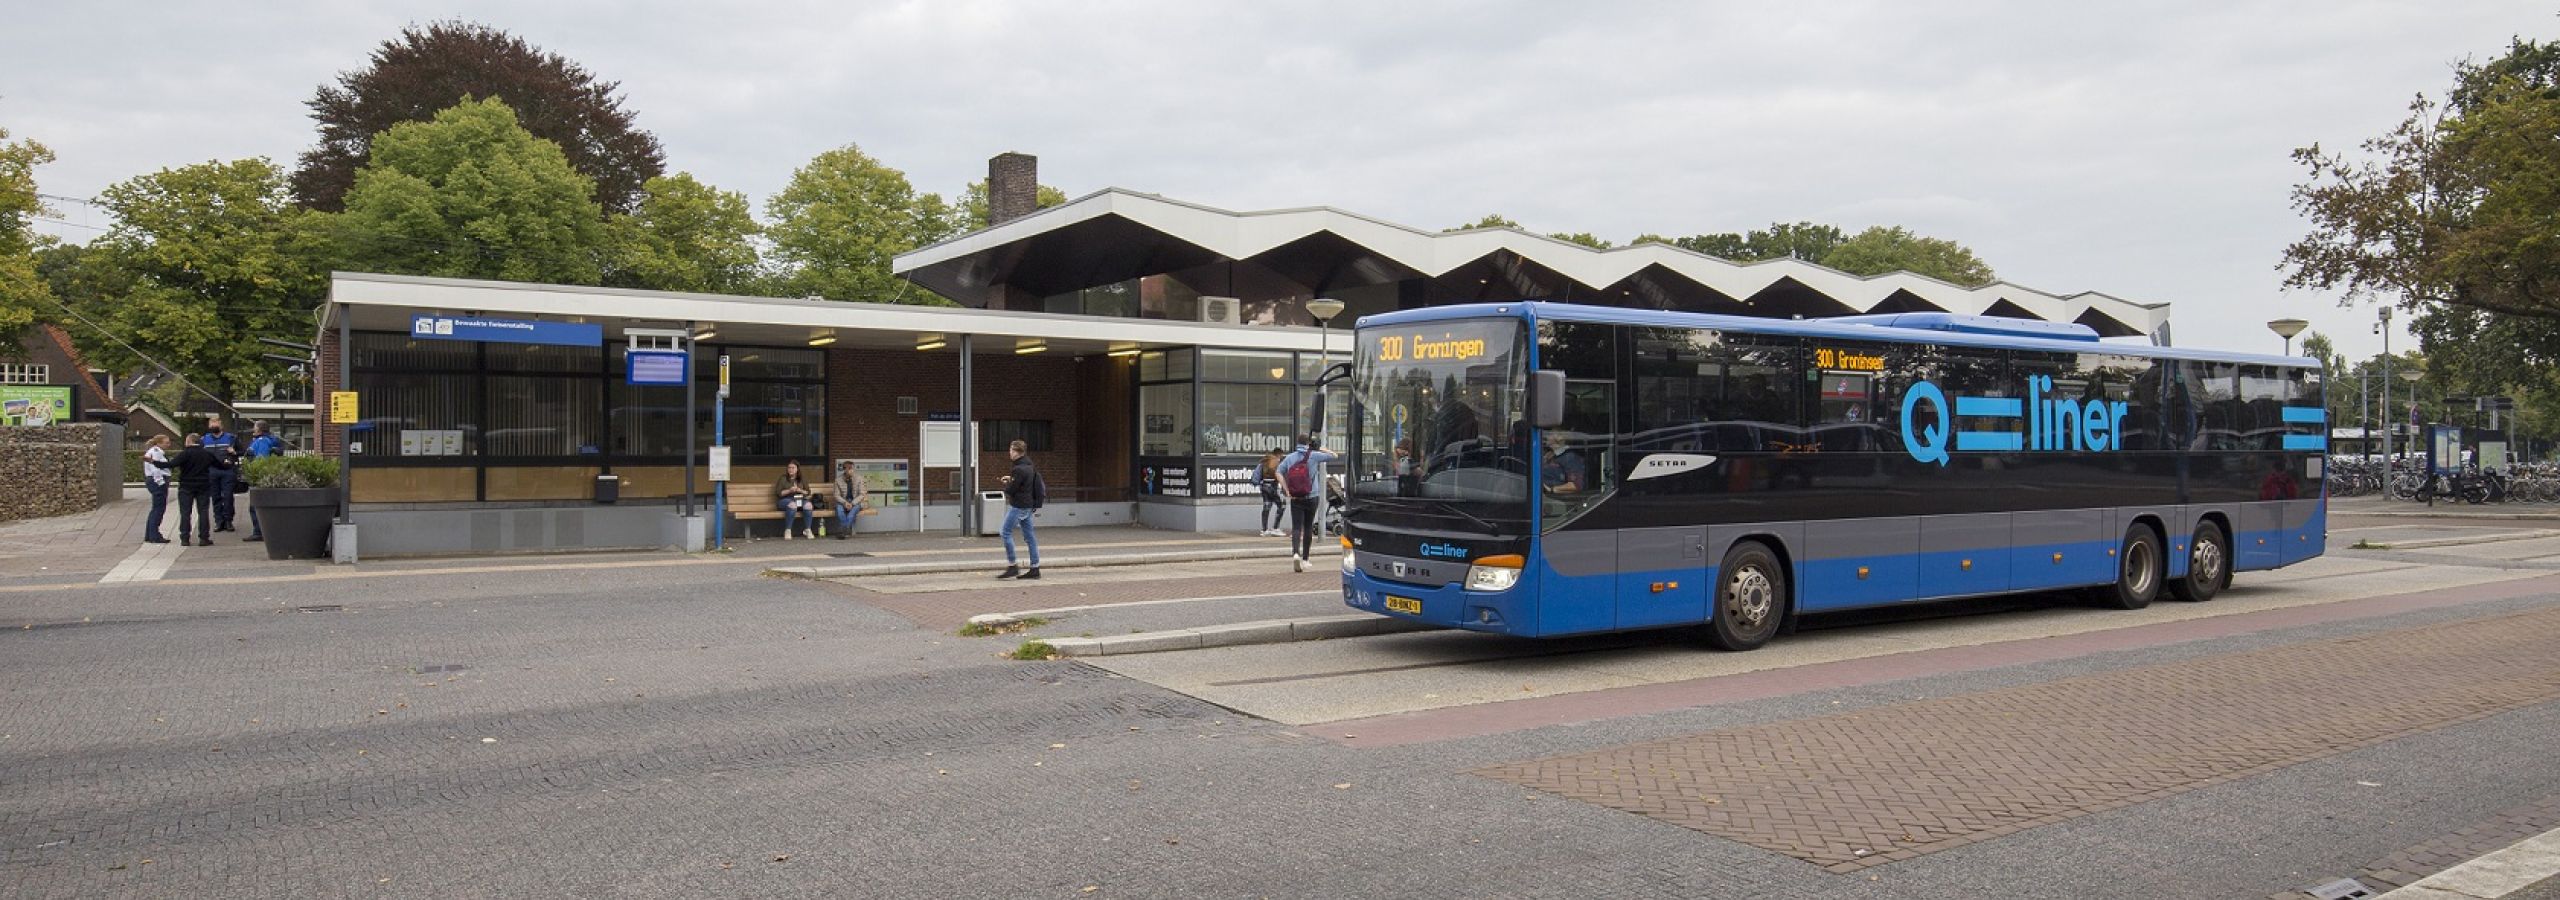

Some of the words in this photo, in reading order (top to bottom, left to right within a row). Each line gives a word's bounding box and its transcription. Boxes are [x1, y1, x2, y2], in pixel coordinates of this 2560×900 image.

[1380, 336, 1403, 361] 300
[1413, 332, 1484, 361] Groningen
[1815, 348, 1834, 369] 300
[1838, 350, 1886, 370] Groningen
[1226, 432, 1290, 451] Welkom
[1227, 467, 1253, 480] verlo
[1372, 561, 1431, 577] SETRA
